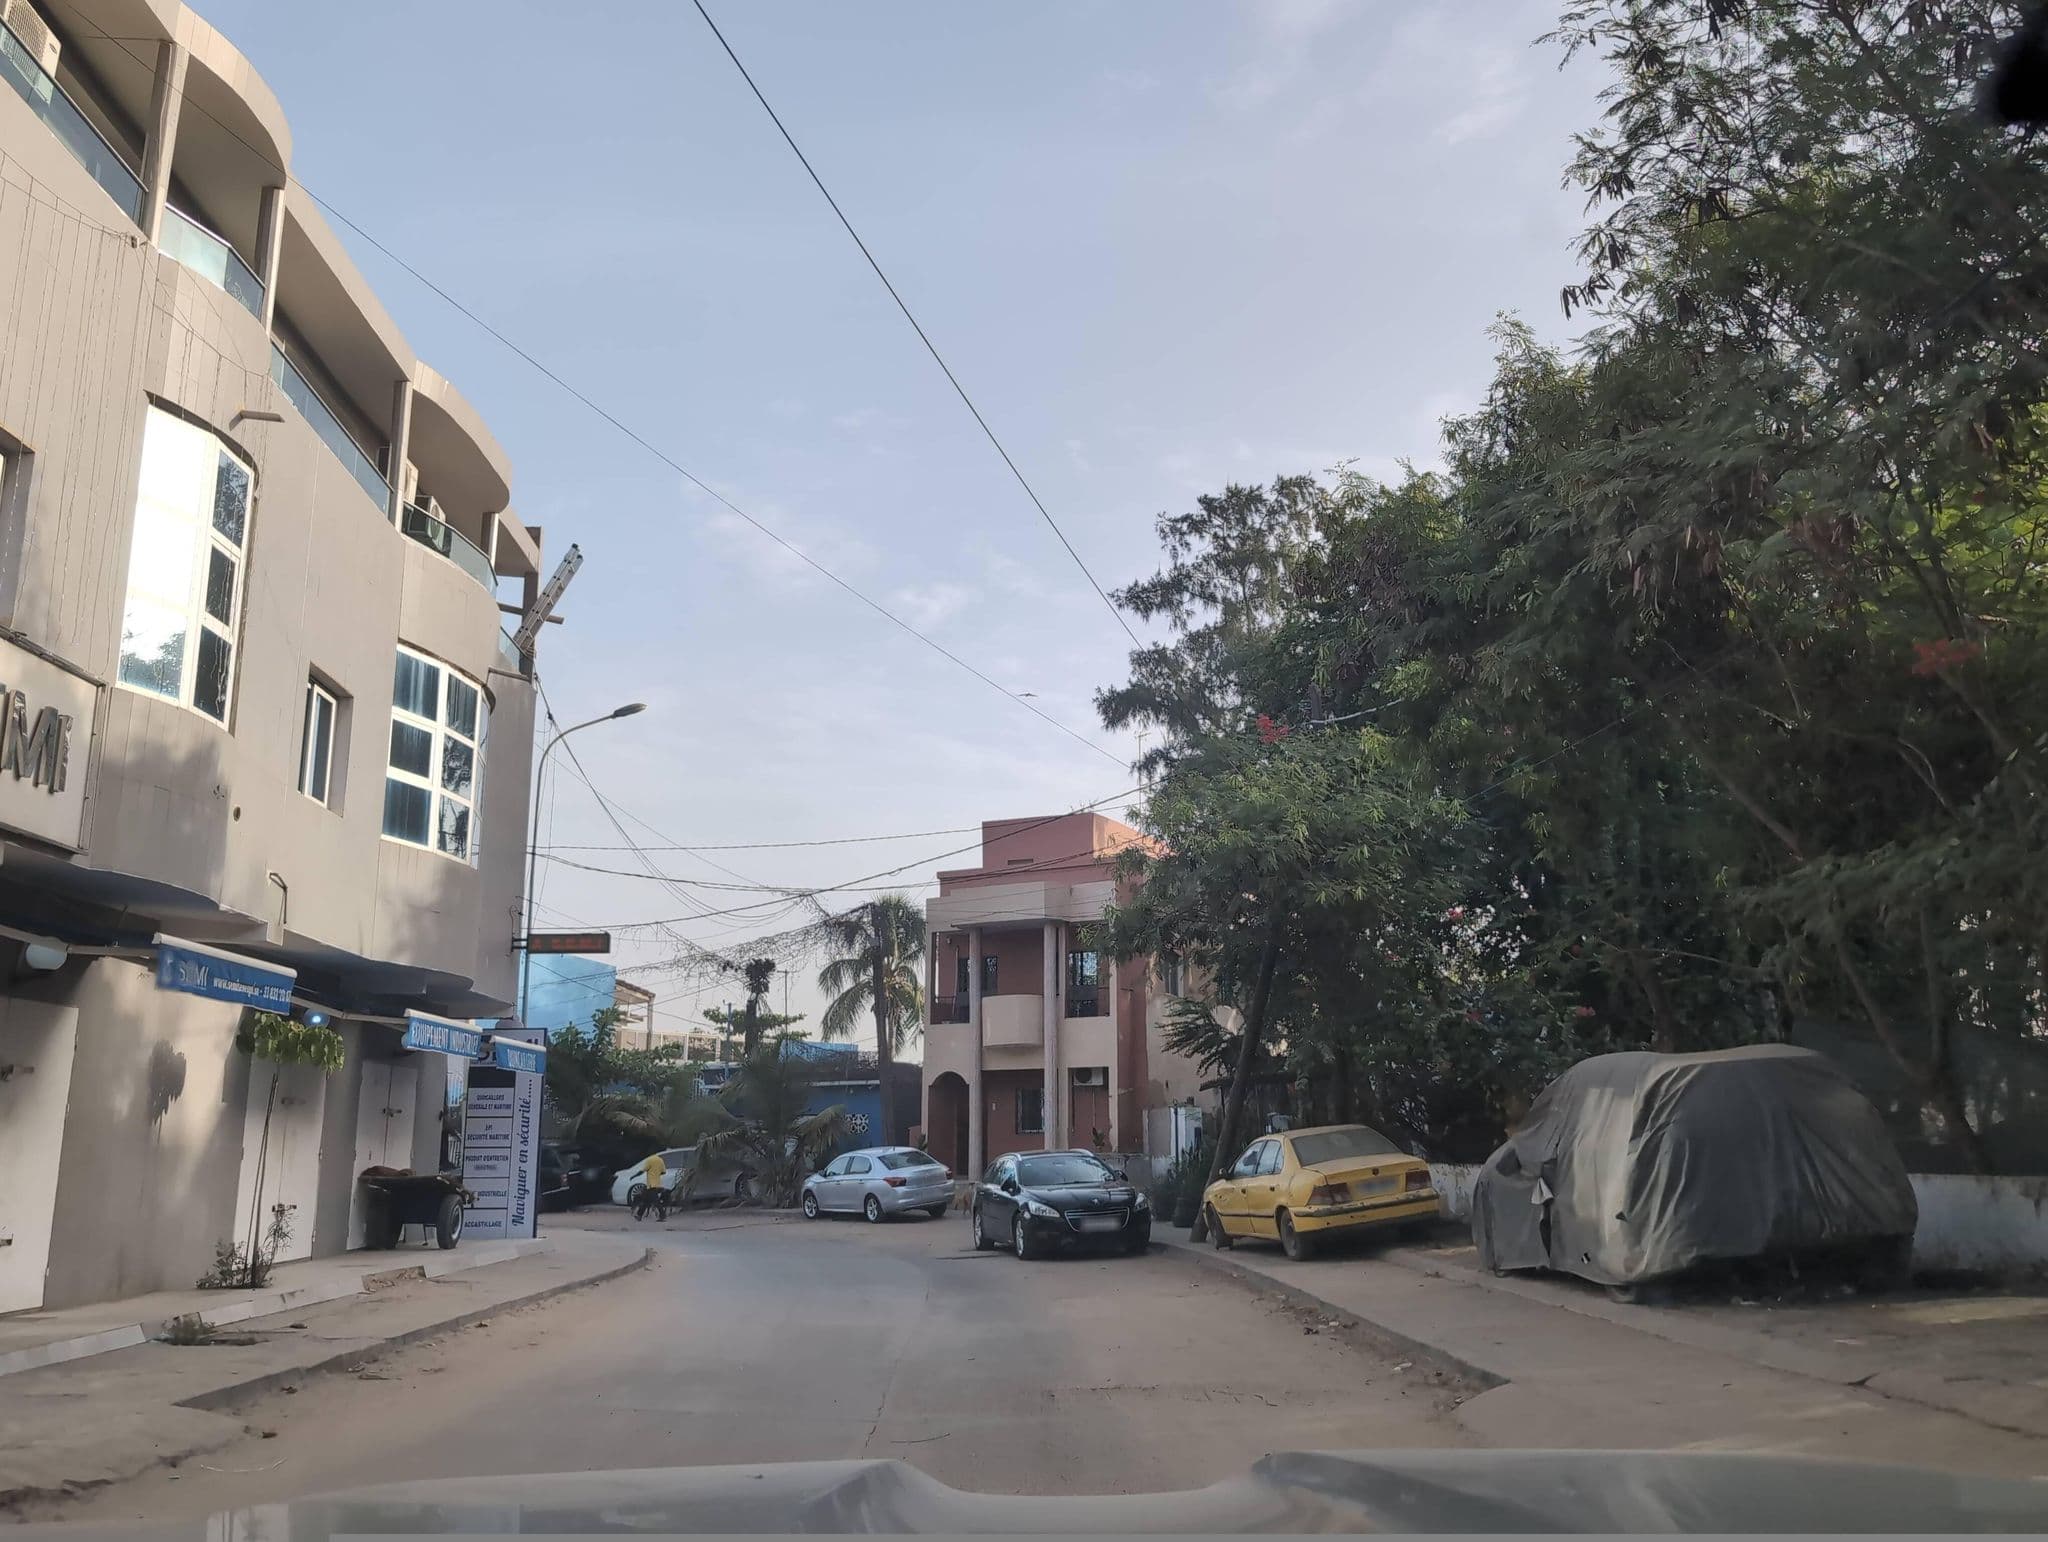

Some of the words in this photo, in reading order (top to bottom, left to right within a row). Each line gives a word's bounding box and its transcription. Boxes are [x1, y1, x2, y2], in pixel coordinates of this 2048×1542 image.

[0, 683, 73, 793] MI
[518, 1147, 528, 1164] en
[512, 1166, 529, 1227] Naviguer
